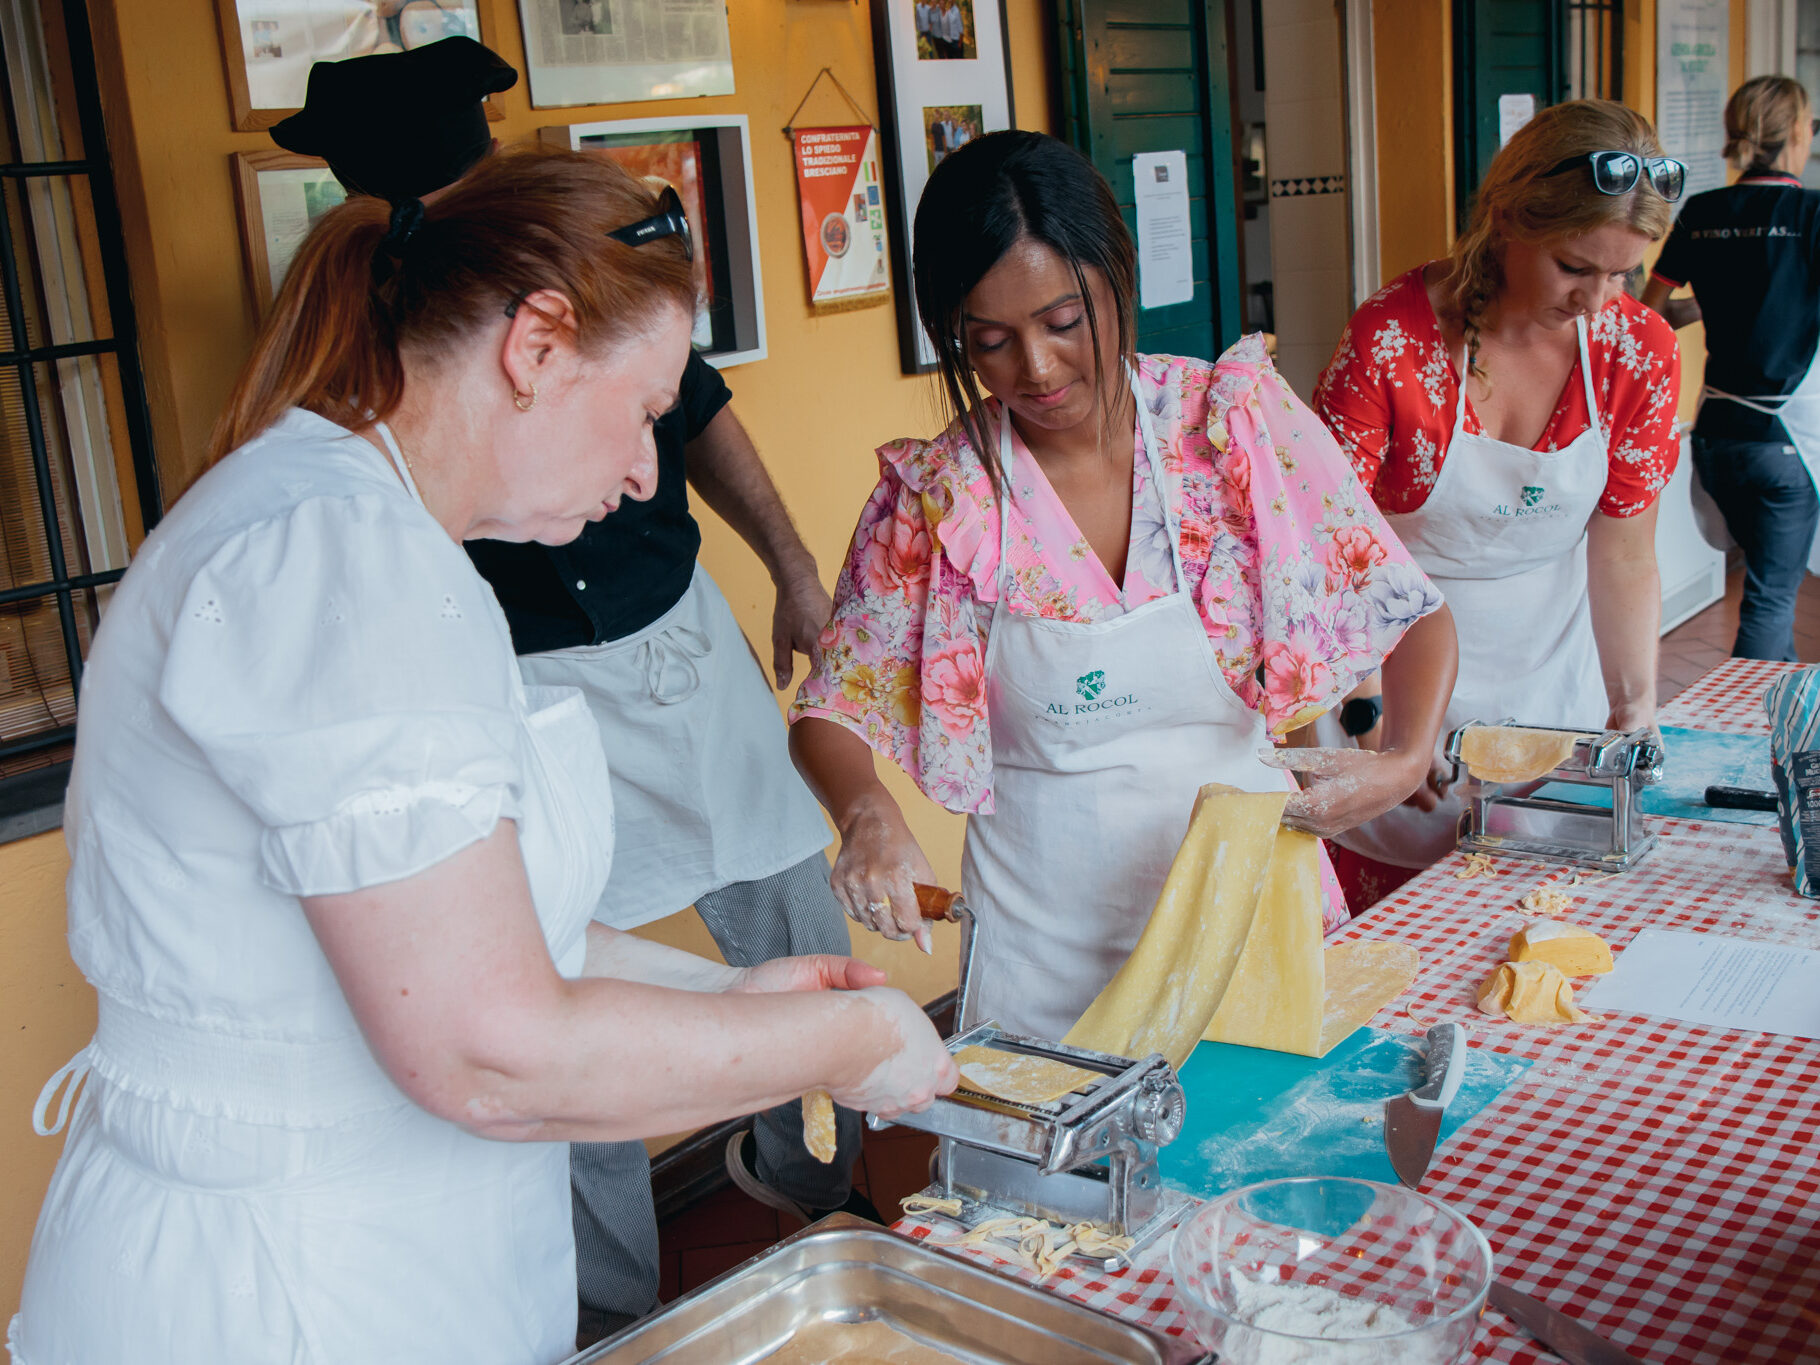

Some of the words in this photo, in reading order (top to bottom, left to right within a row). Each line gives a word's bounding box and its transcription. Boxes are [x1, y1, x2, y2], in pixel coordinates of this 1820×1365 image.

[801, 132, 860, 144] CONFRATERNITA
[801, 146, 812, 155] LO
[814, 144, 841, 154] SPIEDO
[802, 154, 856, 166] TRADIZIONALE
[803, 166, 847, 178] BRESCIANO
[1493, 505, 1511, 516] AL
[1046, 703, 1069, 715] AL
[1075, 694, 1138, 714] ROCOL
